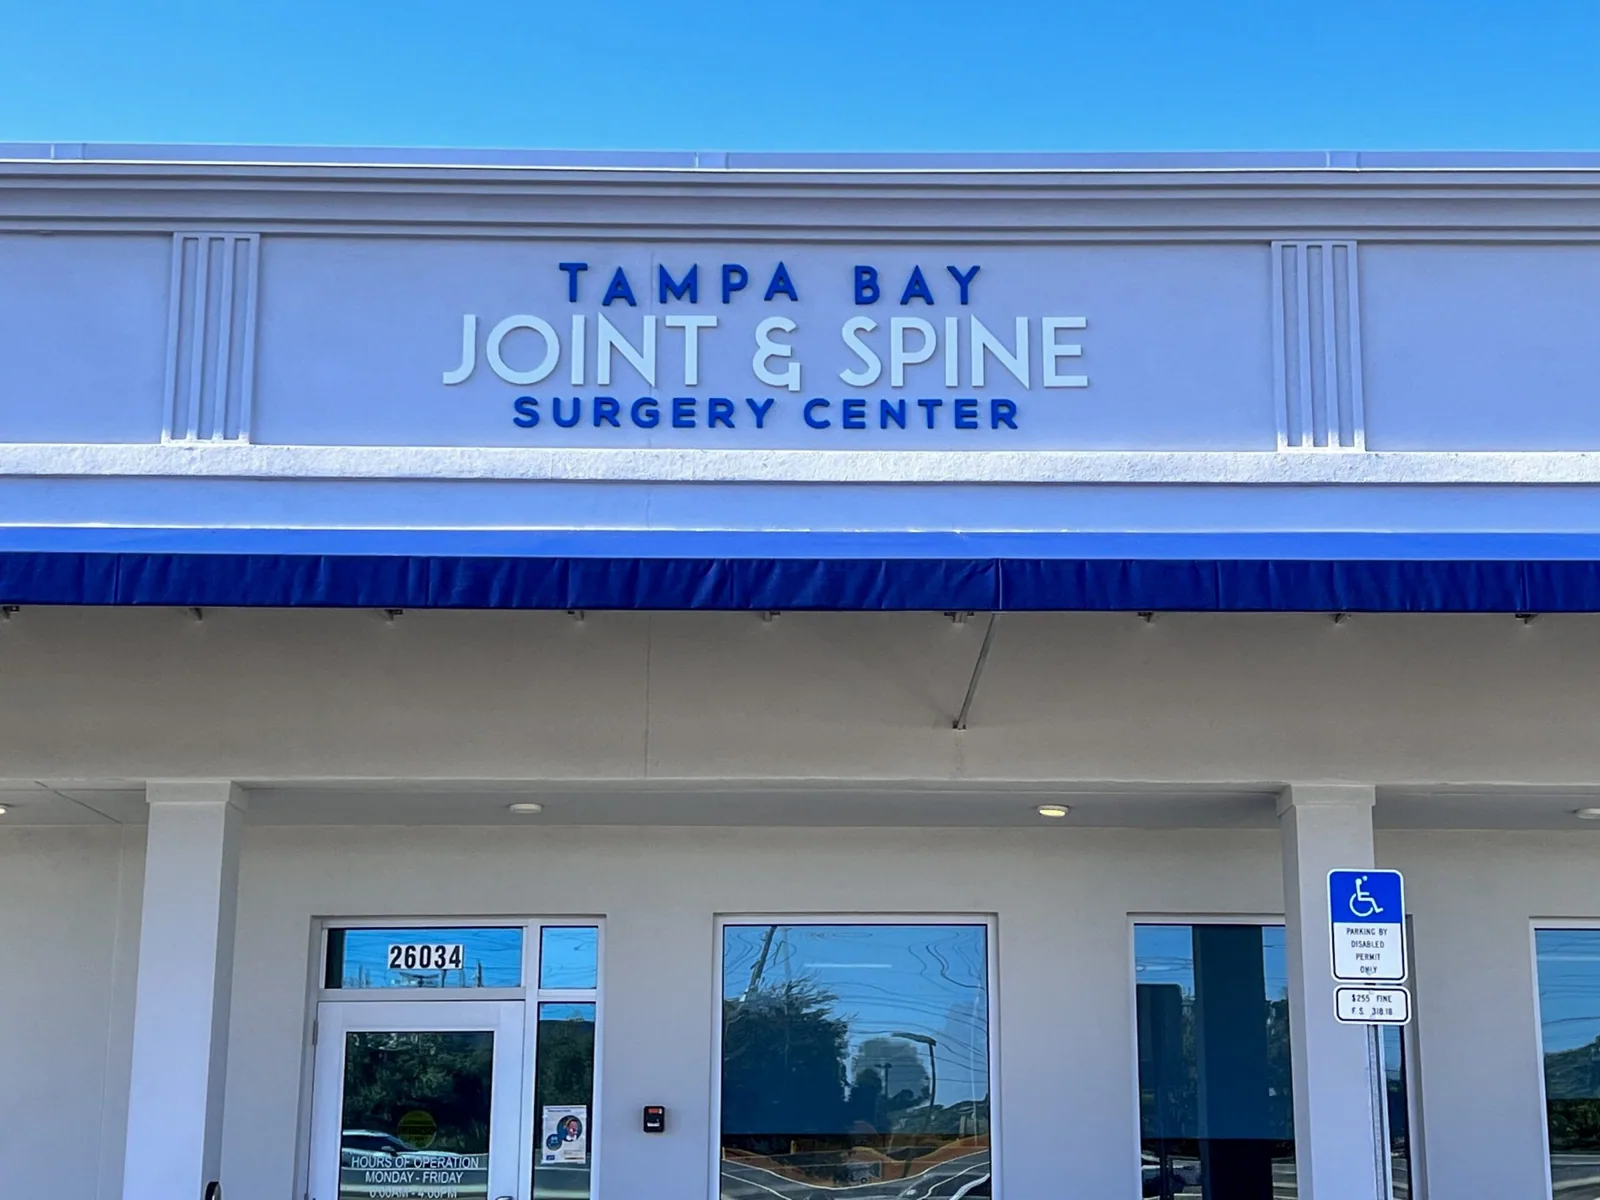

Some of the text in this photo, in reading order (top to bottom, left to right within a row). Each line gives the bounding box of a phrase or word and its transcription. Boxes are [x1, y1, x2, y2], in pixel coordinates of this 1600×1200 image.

[559, 261, 981, 307] TAMPA BAY
[443, 312, 1089, 392] JOINT & SPINE
[513, 396, 1019, 430] SURGERY CENTER
[1346, 927, 1388, 936] PARKING BY
[1350, 940, 1385, 949] DISABLED
[389, 945, 461, 969] 26034
[1355, 953, 1381, 961] PERMIT
[1359, 966, 1377, 974] ONLY
[1352, 994, 1392, 1003] $255 FINE
[351, 1156, 479, 1169] HOURS OF OPERATION
[365, 1171, 414, 1183] MONDAY
[422, 1172, 464, 1183] FRIDAY
